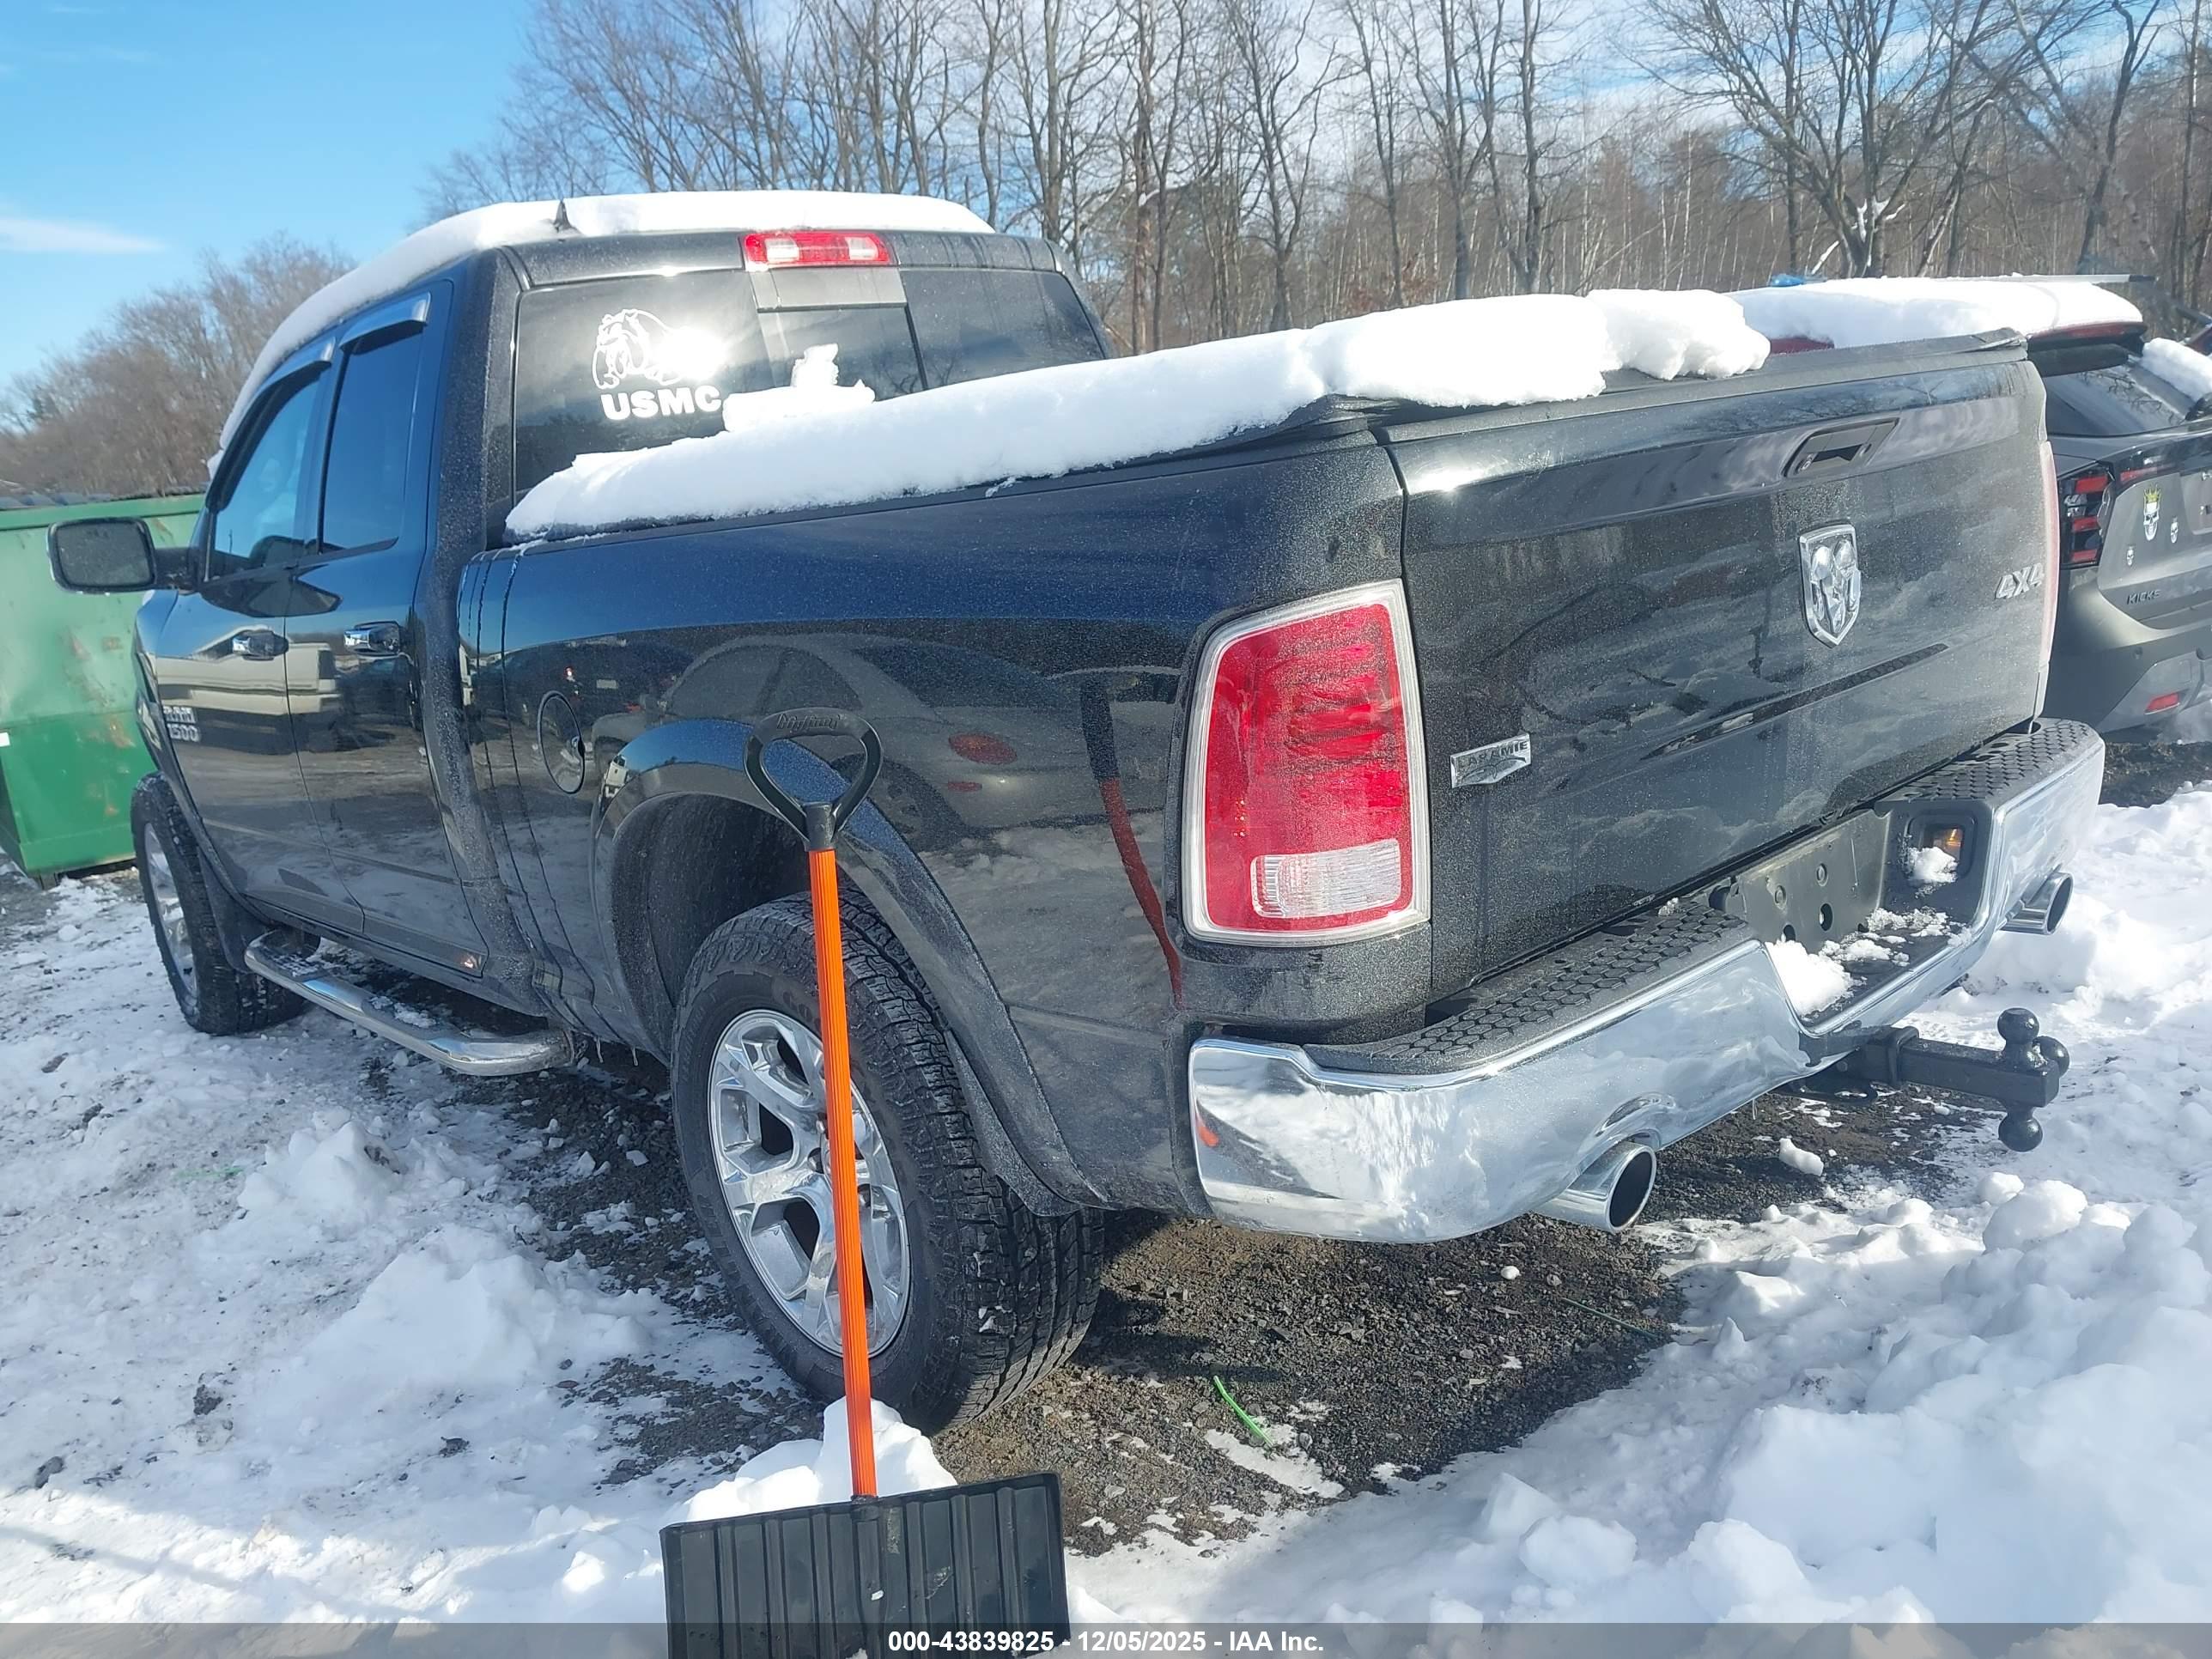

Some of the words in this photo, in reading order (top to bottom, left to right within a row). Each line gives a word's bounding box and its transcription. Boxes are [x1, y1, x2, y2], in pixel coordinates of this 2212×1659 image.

[600, 385, 723, 421] USMC
[2126, 589, 2161, 605] KICKS
[163, 706, 197, 723] RAM
[167, 723, 200, 743] 1500
